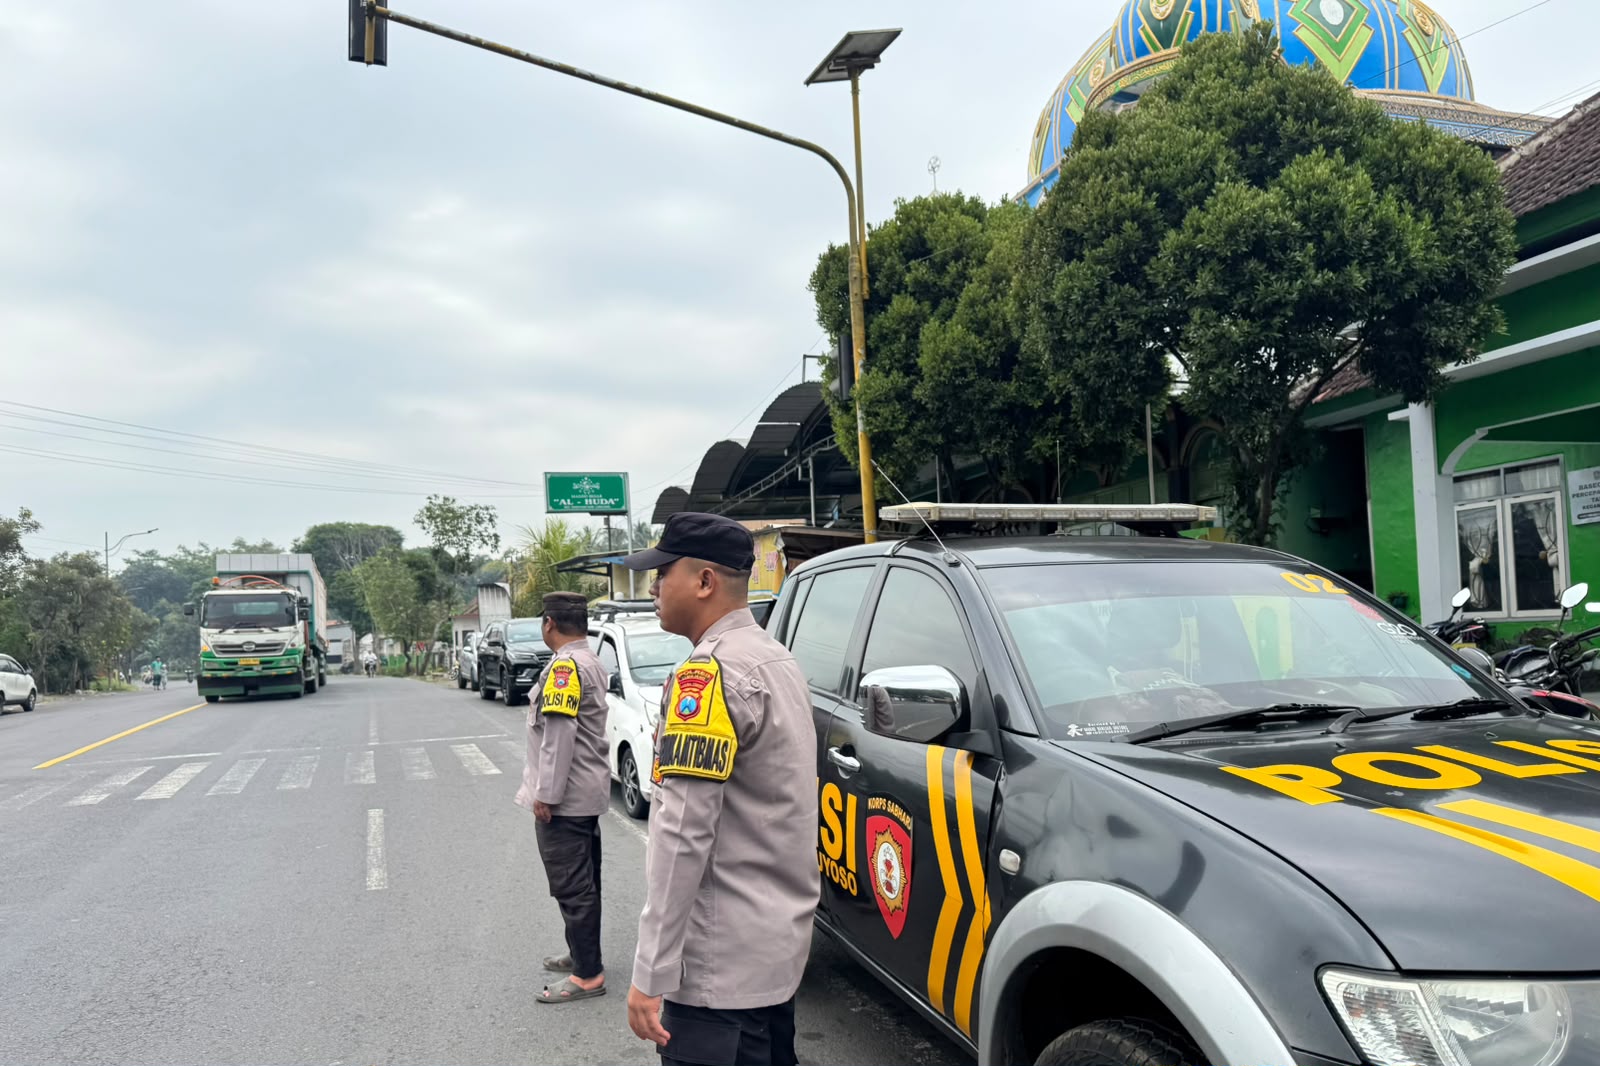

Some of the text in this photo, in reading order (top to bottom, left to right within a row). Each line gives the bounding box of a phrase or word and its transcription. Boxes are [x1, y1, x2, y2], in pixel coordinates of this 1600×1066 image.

[1279, 571, 1349, 595] 02
[1376, 622, 1417, 637] G20
[867, 797, 887, 811] KORPS
[816, 776, 857, 873] SI
